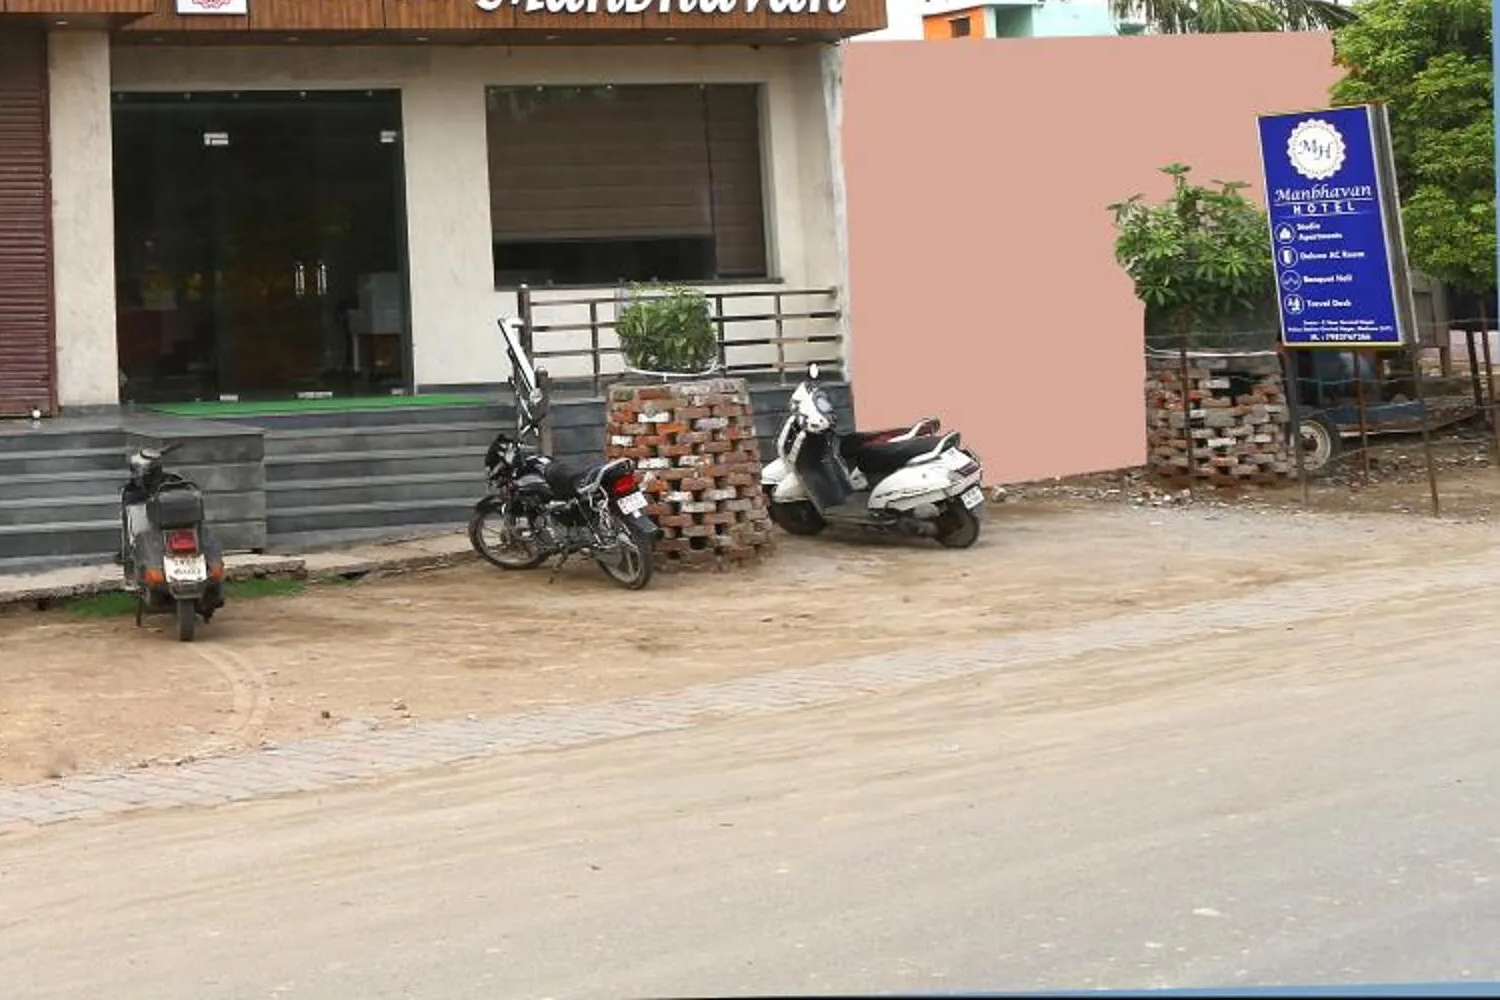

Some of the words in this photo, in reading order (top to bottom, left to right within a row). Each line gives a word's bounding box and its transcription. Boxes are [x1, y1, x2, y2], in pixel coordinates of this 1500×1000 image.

[1297, 138, 1333, 160] MH
[1273, 184, 1372, 202] Manbhavan
[1293, 201, 1355, 214] HOTEL
